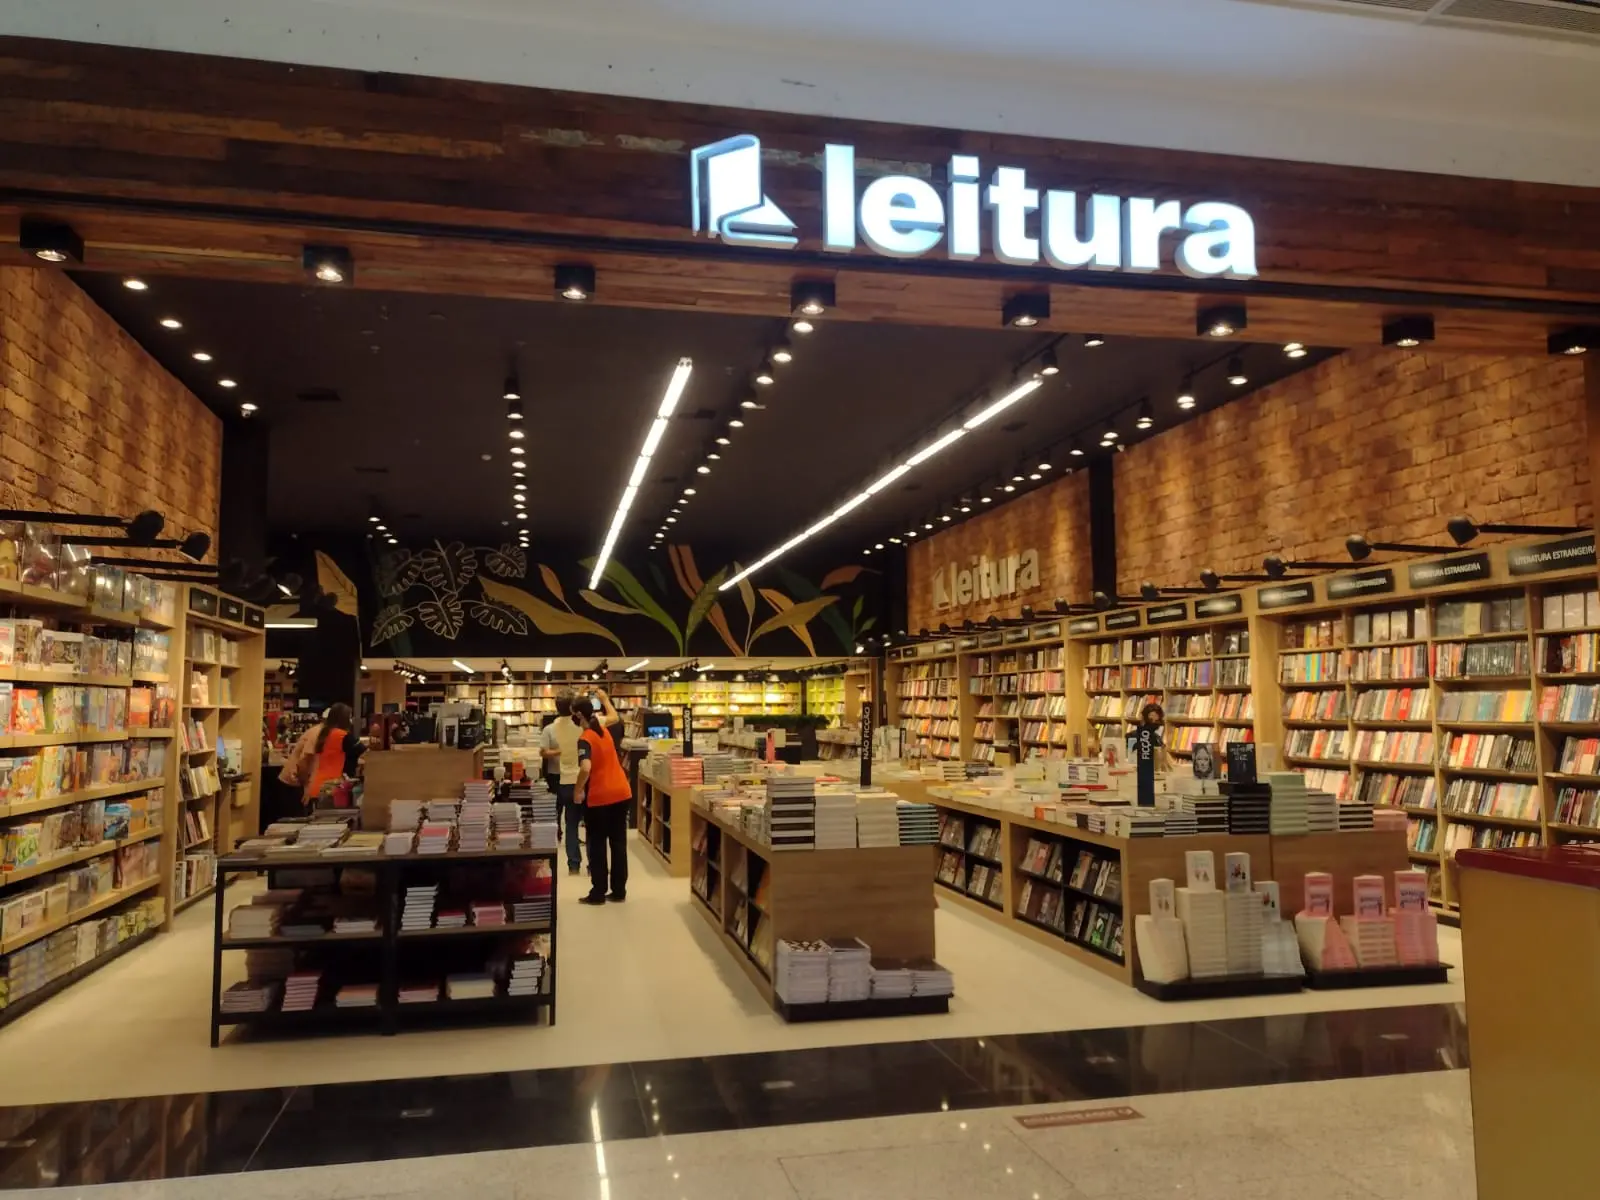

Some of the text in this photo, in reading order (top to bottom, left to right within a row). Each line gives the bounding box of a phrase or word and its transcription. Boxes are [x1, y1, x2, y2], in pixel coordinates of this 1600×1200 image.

[821, 142, 1259, 281] leitura
[1514, 551, 1552, 566] LITERATURA
[950, 548, 1041, 608] leitura
[863, 706, 871, 738] FICÇÃO
[1140, 730, 1152, 760] FICÇÃO
